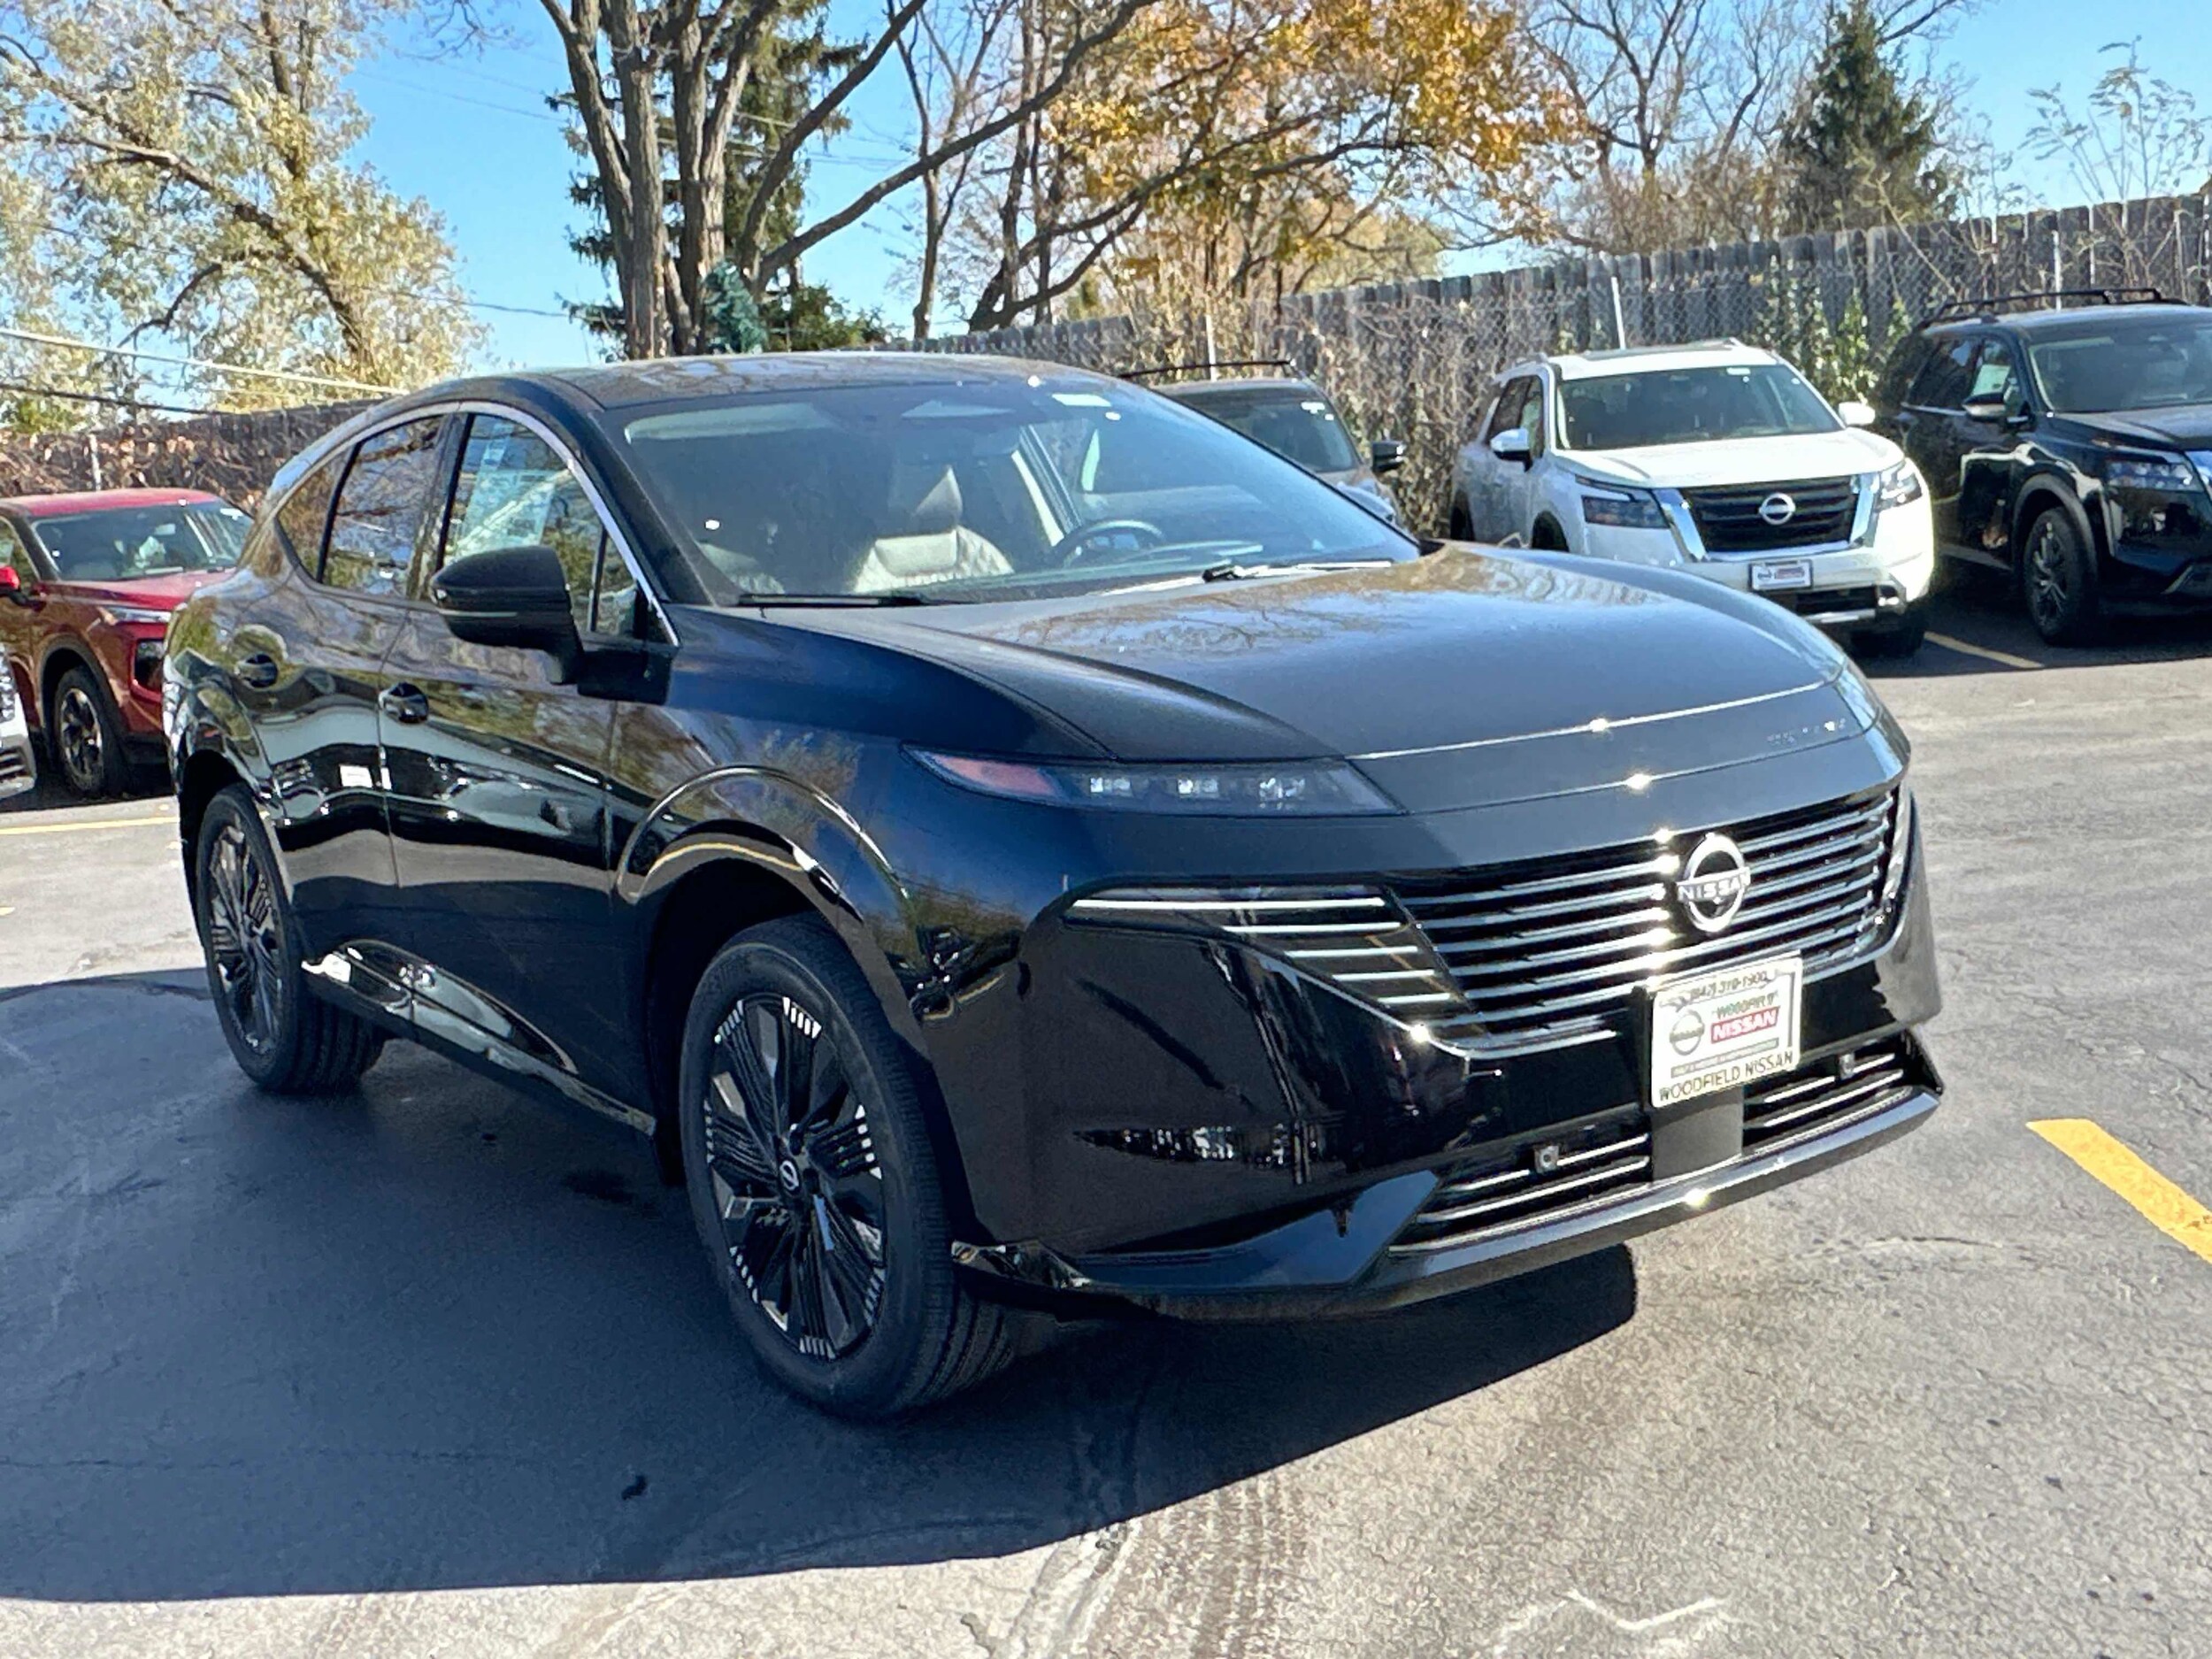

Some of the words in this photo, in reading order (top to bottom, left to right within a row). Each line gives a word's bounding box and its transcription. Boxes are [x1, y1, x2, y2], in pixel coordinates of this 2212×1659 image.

[1678, 870, 1749, 901] NISSAN
[1713, 1009, 1778, 1041] NISSAN
[1659, 1065, 1741, 1101] WOODFIELD
[1745, 1050, 1793, 1076] NISSAN
